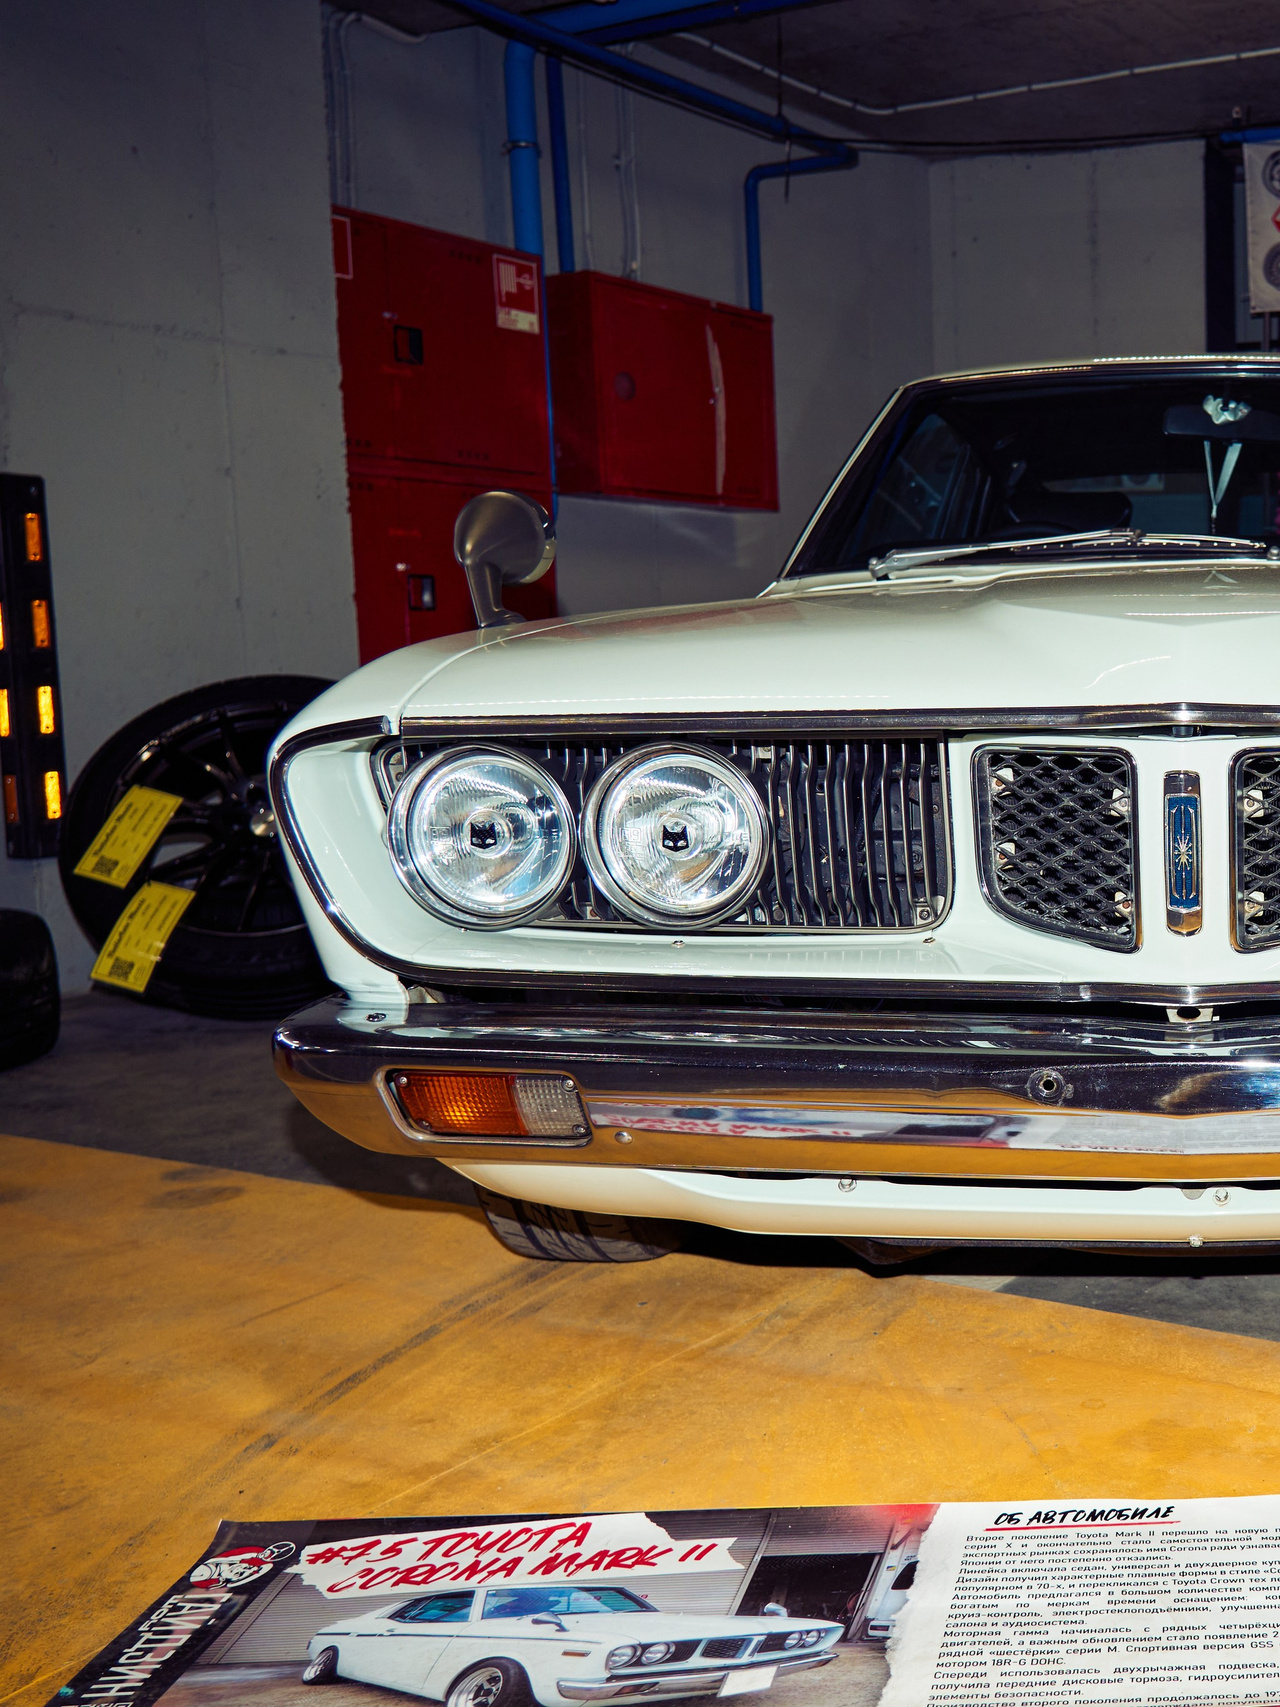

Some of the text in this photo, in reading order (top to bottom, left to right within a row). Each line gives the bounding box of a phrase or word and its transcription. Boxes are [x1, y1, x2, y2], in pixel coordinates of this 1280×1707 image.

[993, 1505, 1176, 1526] ОБ АВТОМОБИЛЕ
[1161, 1529, 1208, 1537] перешло
[305, 1521, 592, 1567] #75 TOYOTA
[1159, 1535, 1252, 1544] самостоятельной
[327, 1556, 513, 1594] CORONA
[528, 1544, 675, 1577] MARK
[1027, 1590, 1101, 1599] предлагался
[1120, 1588, 1171, 1596] большом
[1176, 1586, 1242, 1594] количестве
[1046, 1600, 1090, 1608] меркам
[1106, 1598, 1156, 1606] времени
[1060, 1626, 1131, 1634] начиналась
[1161, 1624, 1206, 1633] рядных
[1081, 1636, 1162, 1644] обновлением
[1203, 1632, 1268, 1640] появление
[937, 1647, 983, 1659] рядной
[1065, 1647, 1102, 1655] серии
[1125, 1644, 1197, 1653] Спортивная
[1202, 1642, 1244, 1651] версия
[935, 1660, 987, 1669] мотором
[933, 1670, 987, 1680] Спереди
[999, 1668, 1100, 1677] использовалась
[1112, 1664, 1206, 1674] двухрычажная
[930, 1682, 990, 1691] получила
[995, 1680, 1056, 1689] передние
[1061, 1677, 1123, 1686] дисковые
[928, 1692, 990, 1701] элементы
